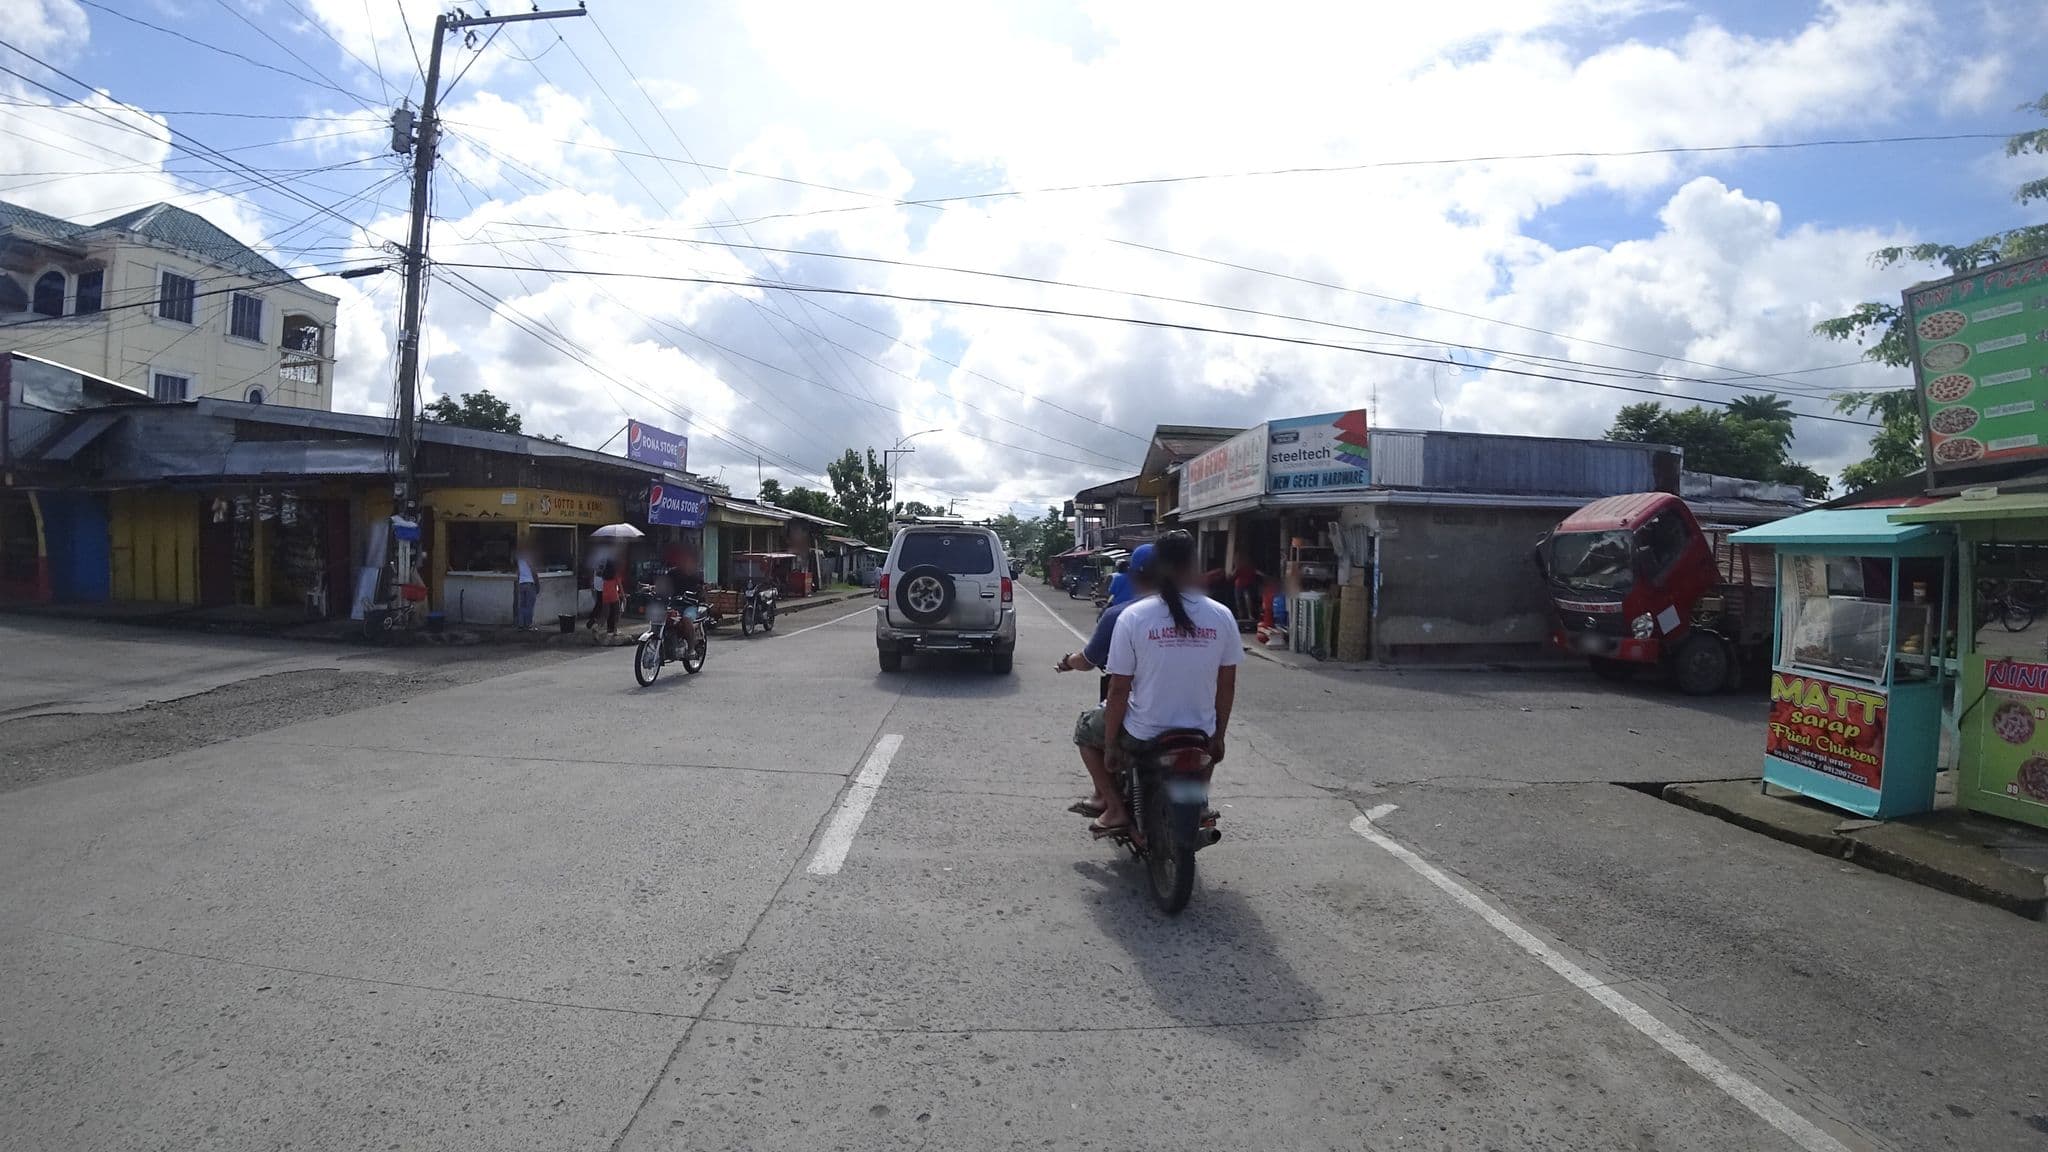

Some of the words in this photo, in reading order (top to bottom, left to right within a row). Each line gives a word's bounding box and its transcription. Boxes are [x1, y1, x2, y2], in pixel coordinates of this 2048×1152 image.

[642, 436, 660, 450] RONA
[660, 442, 678, 455] STORE
[1271, 447, 1330, 463] steeltech
[1273, 475, 1290, 489] NEW
[1322, 470, 1364, 486] HARDWARE
[554, 498, 574, 509] LOTTO
[662, 497, 680, 510] RONA
[681, 500, 699, 513] STORE
[1148, 628, 1160, 640] ALL
[1771, 673, 1887, 725] MATT
[1791, 711, 1861, 738] sarap
[1770, 722, 1812, 746] Fried
[1816, 736, 1879, 765] Chicken
[1801, 749, 1827, 761] accept
[1830, 758, 1852, 769] order
